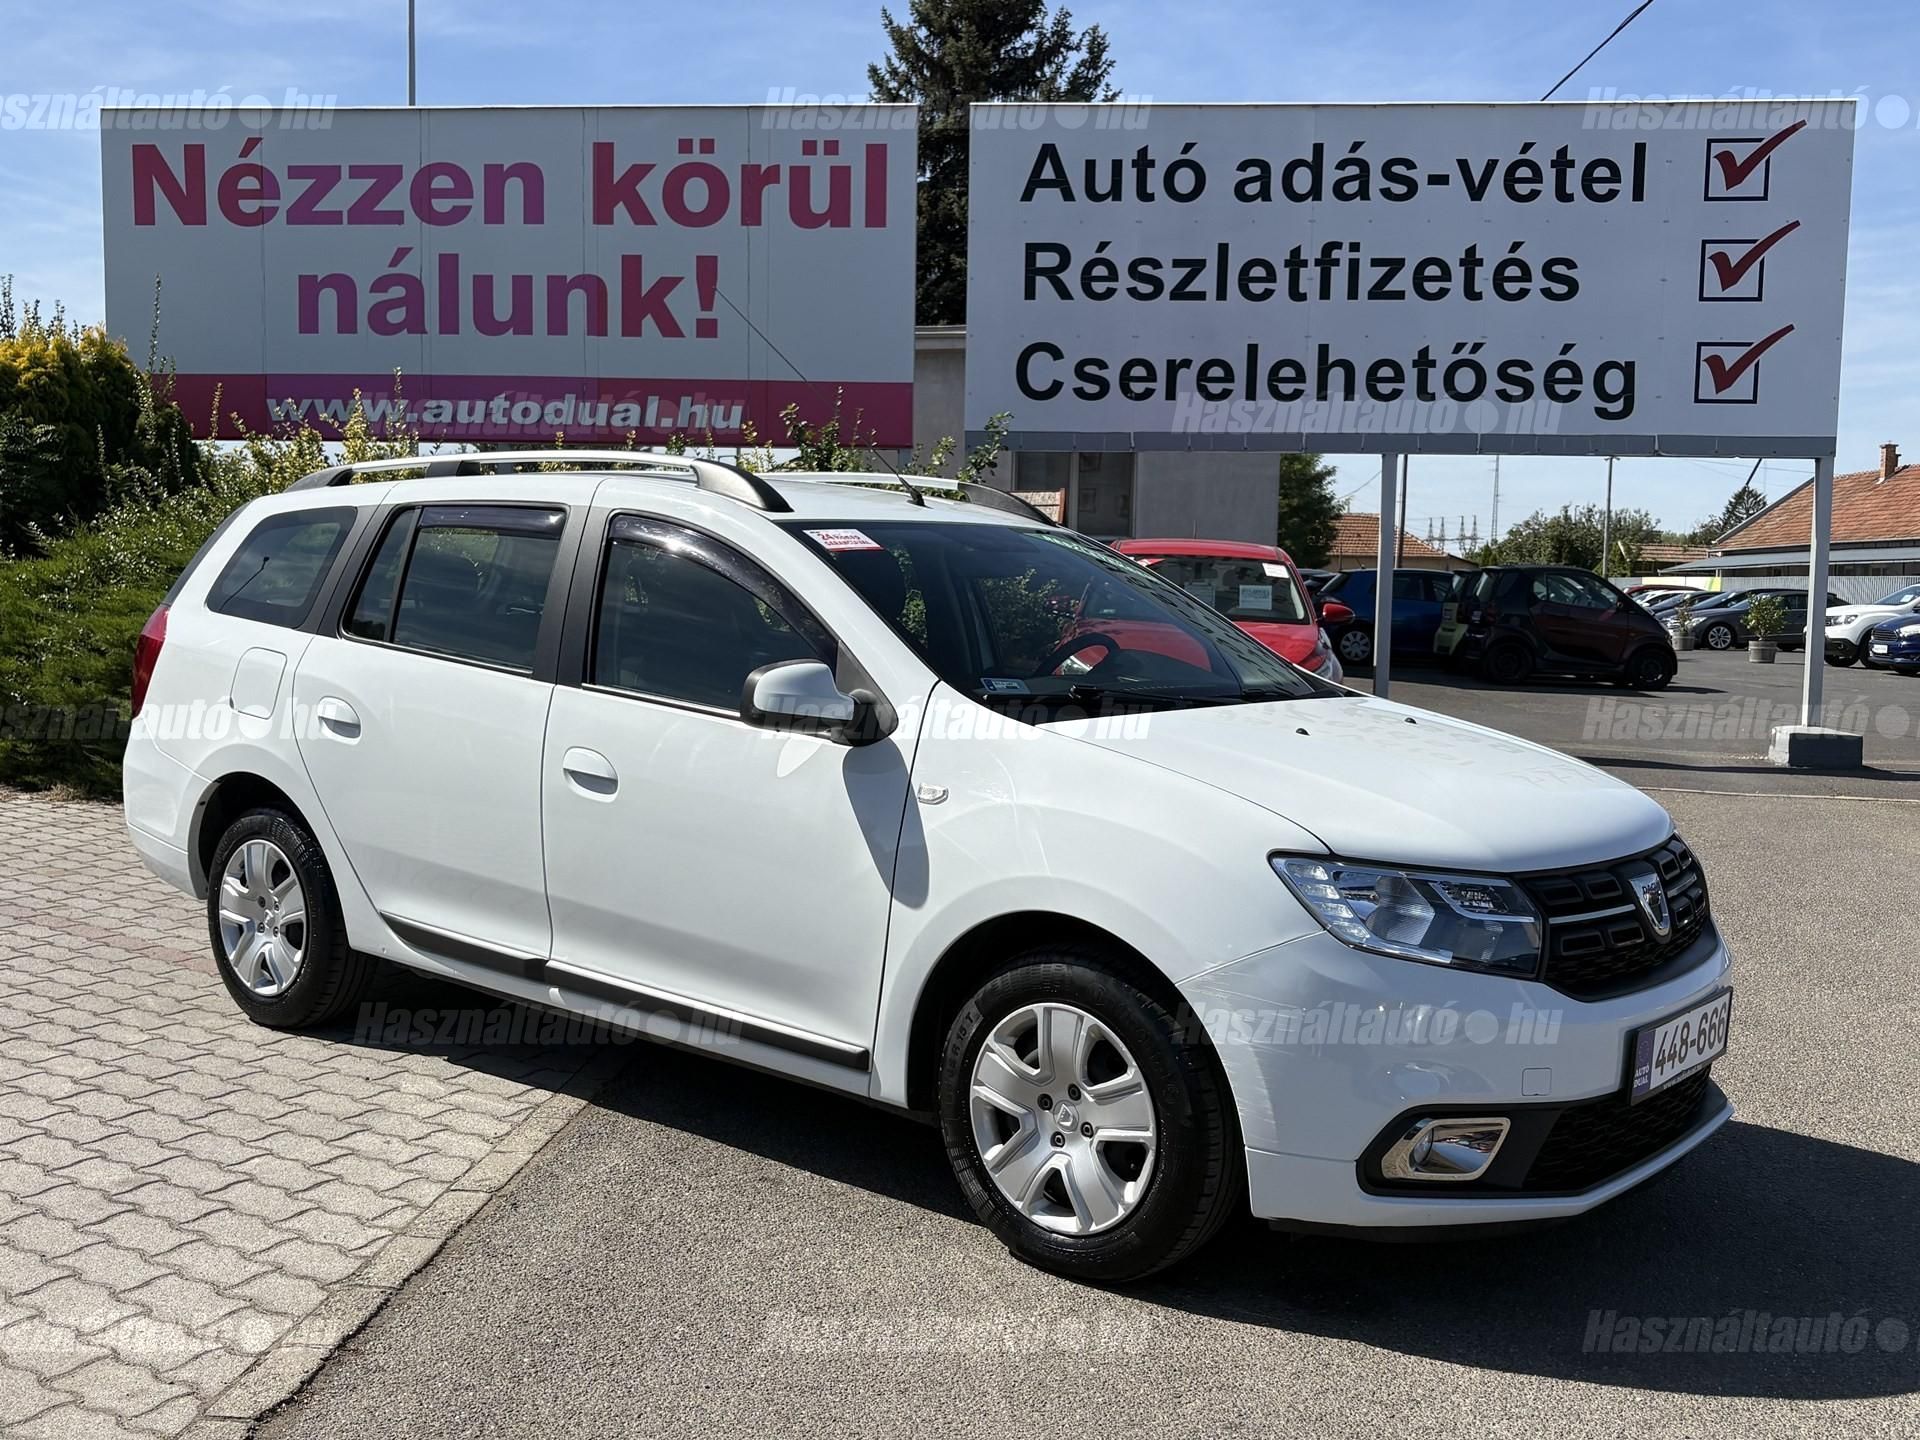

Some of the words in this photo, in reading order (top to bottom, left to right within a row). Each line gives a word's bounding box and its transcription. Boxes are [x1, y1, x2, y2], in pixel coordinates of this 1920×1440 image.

[132, 137, 545, 226] Nézzen
[592, 138, 888, 229] körül
[1019, 141, 1204, 202] Autó
[1235, 141, 1647, 202] adás-vétel
[298, 247, 718, 338] nálunk!
[1024, 240, 1580, 302] Részletfizetés
[1015, 340, 1636, 420] Cserelehetőség
[1654, 1001, 1727, 1076] 448-666
